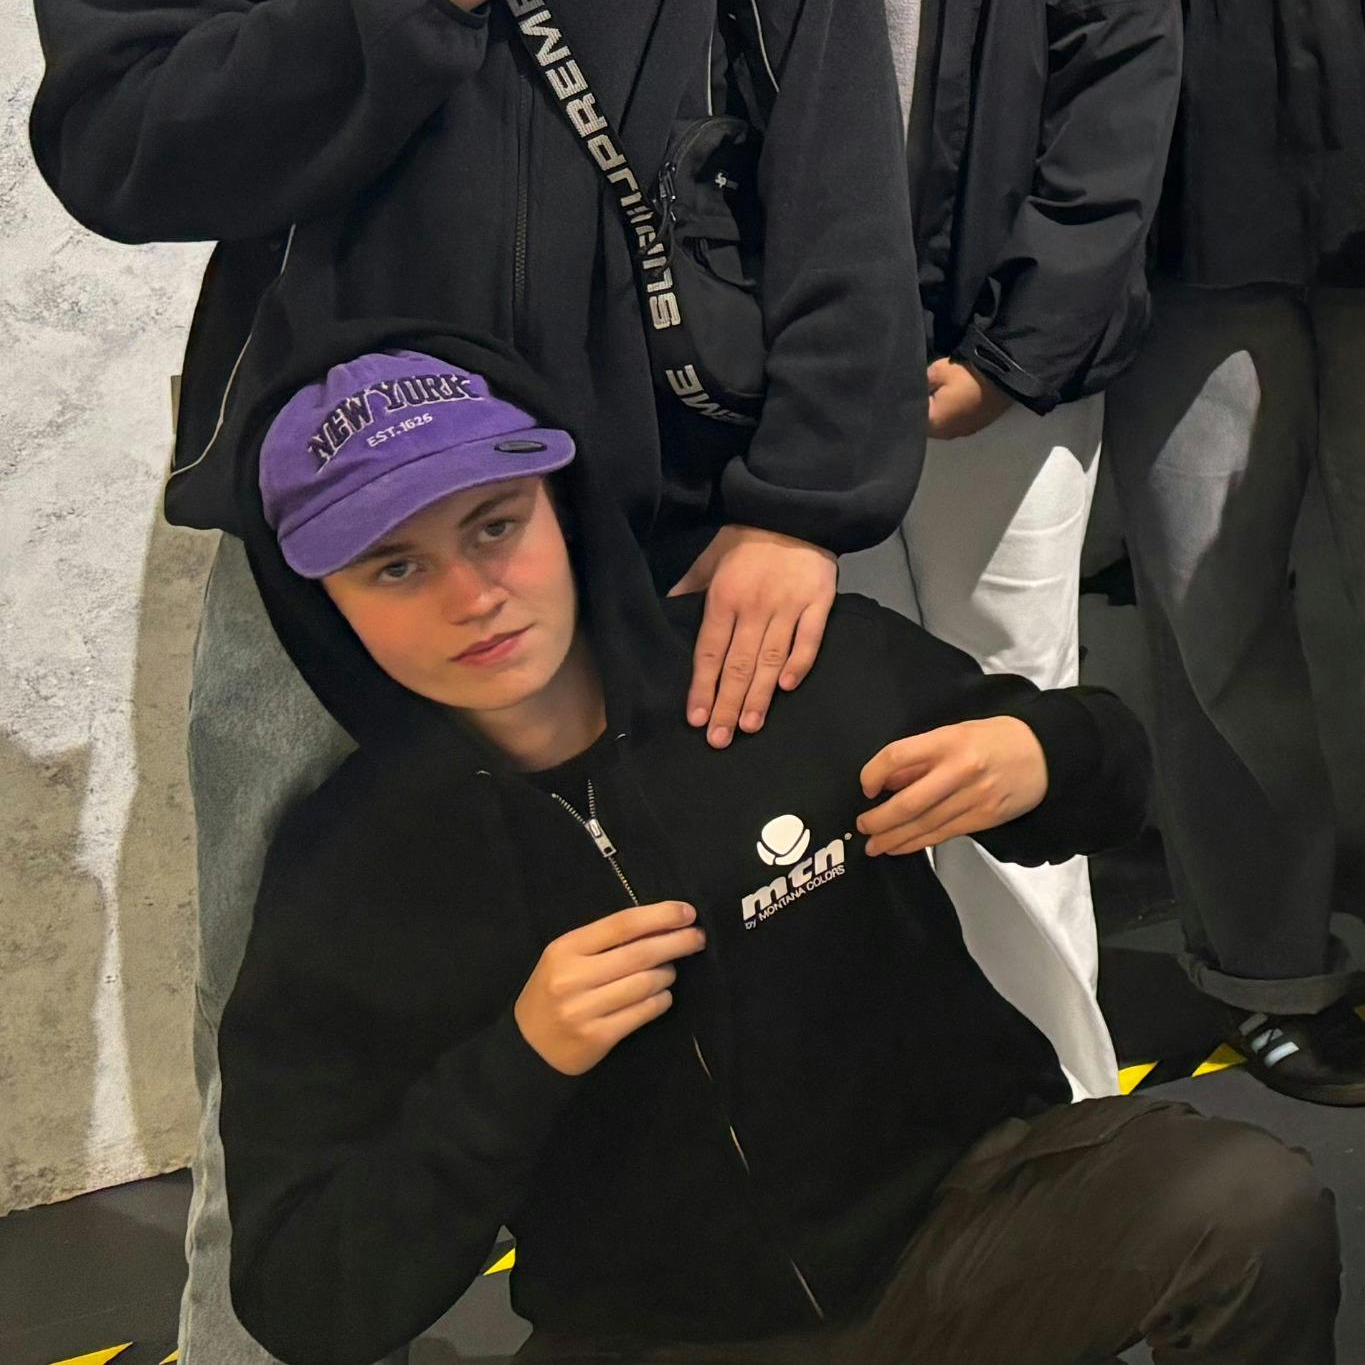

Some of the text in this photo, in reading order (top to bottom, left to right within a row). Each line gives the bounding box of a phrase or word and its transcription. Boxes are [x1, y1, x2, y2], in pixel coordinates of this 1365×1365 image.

[307, 373, 485, 474] NEW YORK
[741, 838, 846, 921] mtn
[758, 887, 807, 922] MONTANA
[806, 865, 846, 892] COLORS
